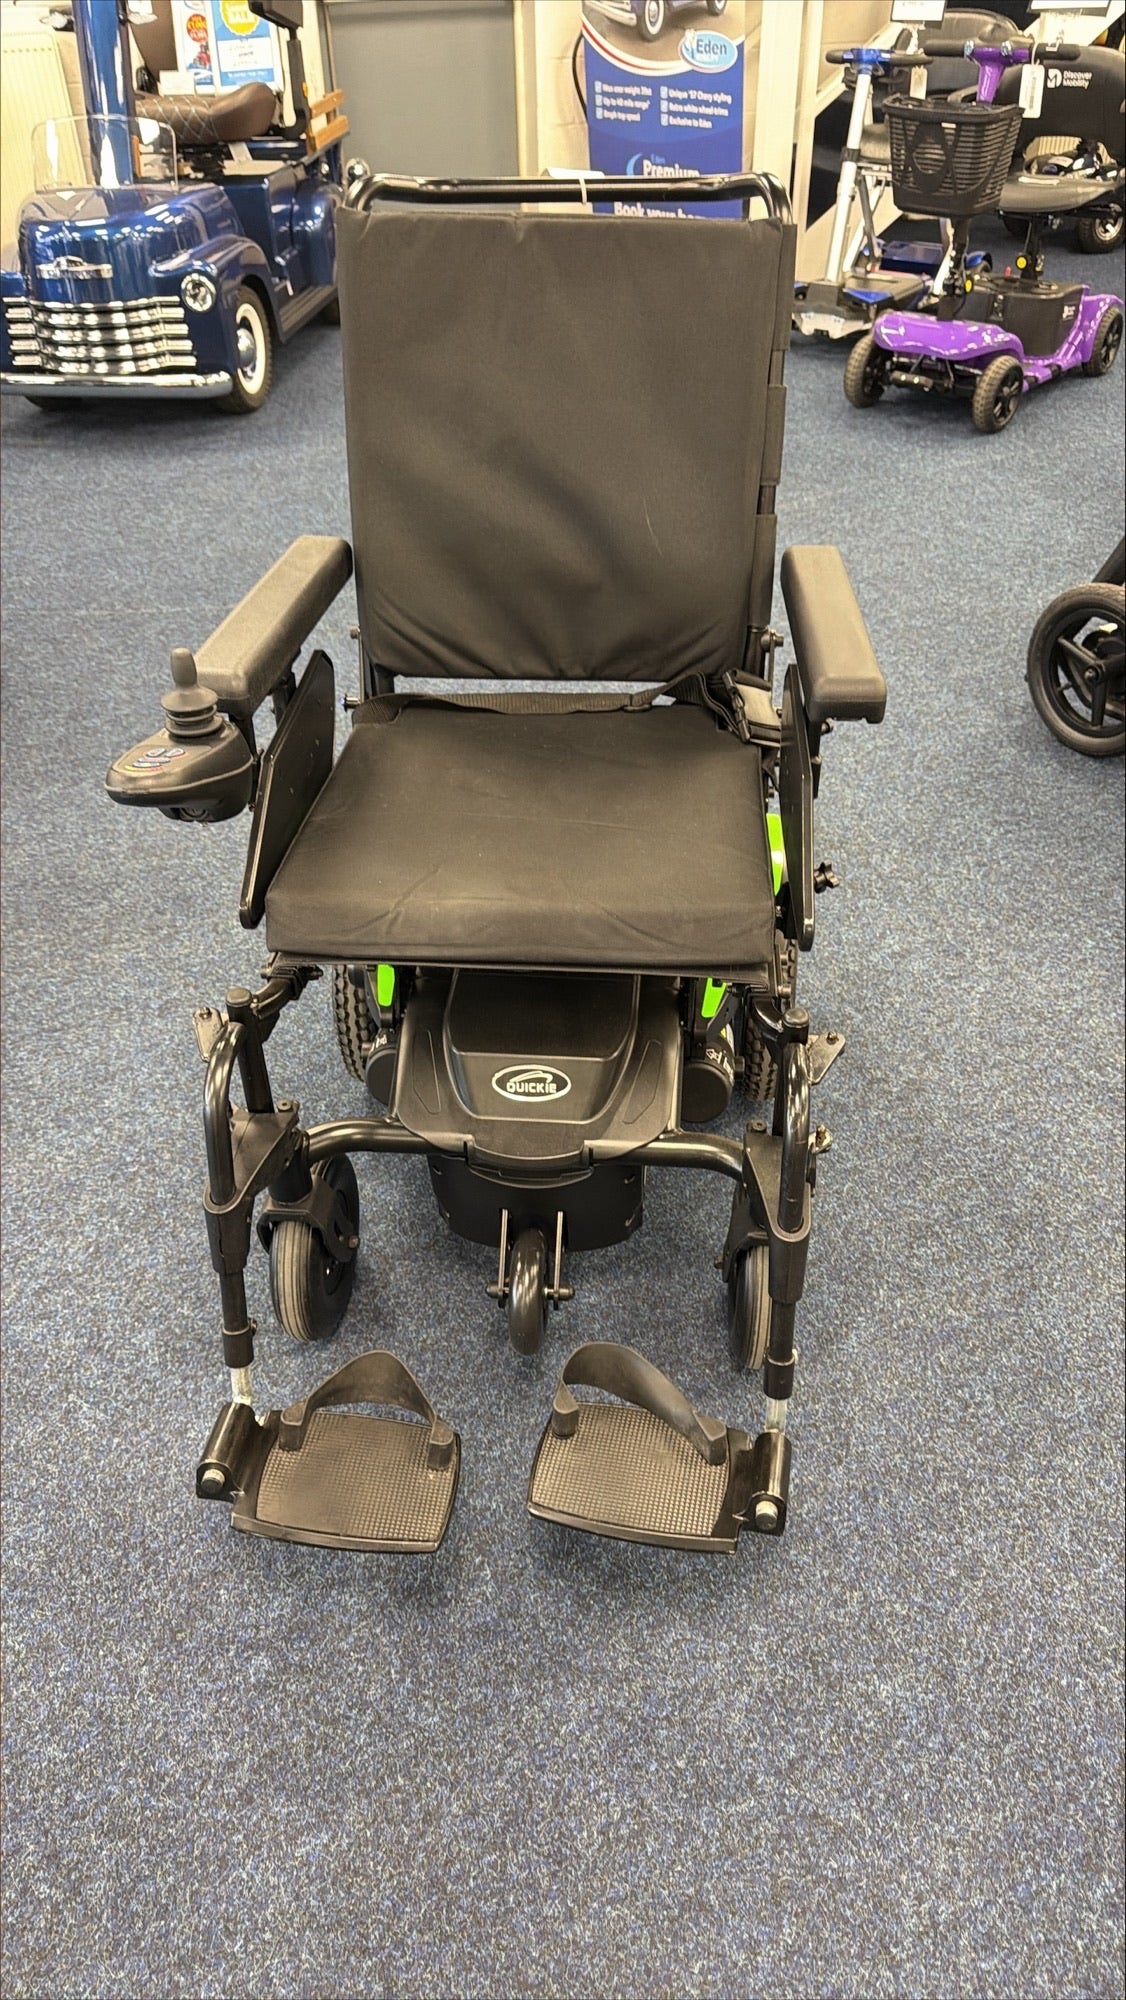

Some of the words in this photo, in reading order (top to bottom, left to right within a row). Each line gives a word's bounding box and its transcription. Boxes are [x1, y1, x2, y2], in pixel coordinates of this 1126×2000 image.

[696, 39, 727, 55] Eden
[1063, 70, 1092, 80] Discover
[1063, 79, 1089, 89] Mobility
[668, 88, 688, 101] Unique
[713, 92, 731, 104] styling
[683, 103, 698, 114] white
[669, 115, 693, 127] Exclusive
[692, 118, 699, 127] to
[643, 159, 700, 177] Premium
[614, 201, 645, 217] Book
[506, 1081, 557, 1094] QUICKIE
